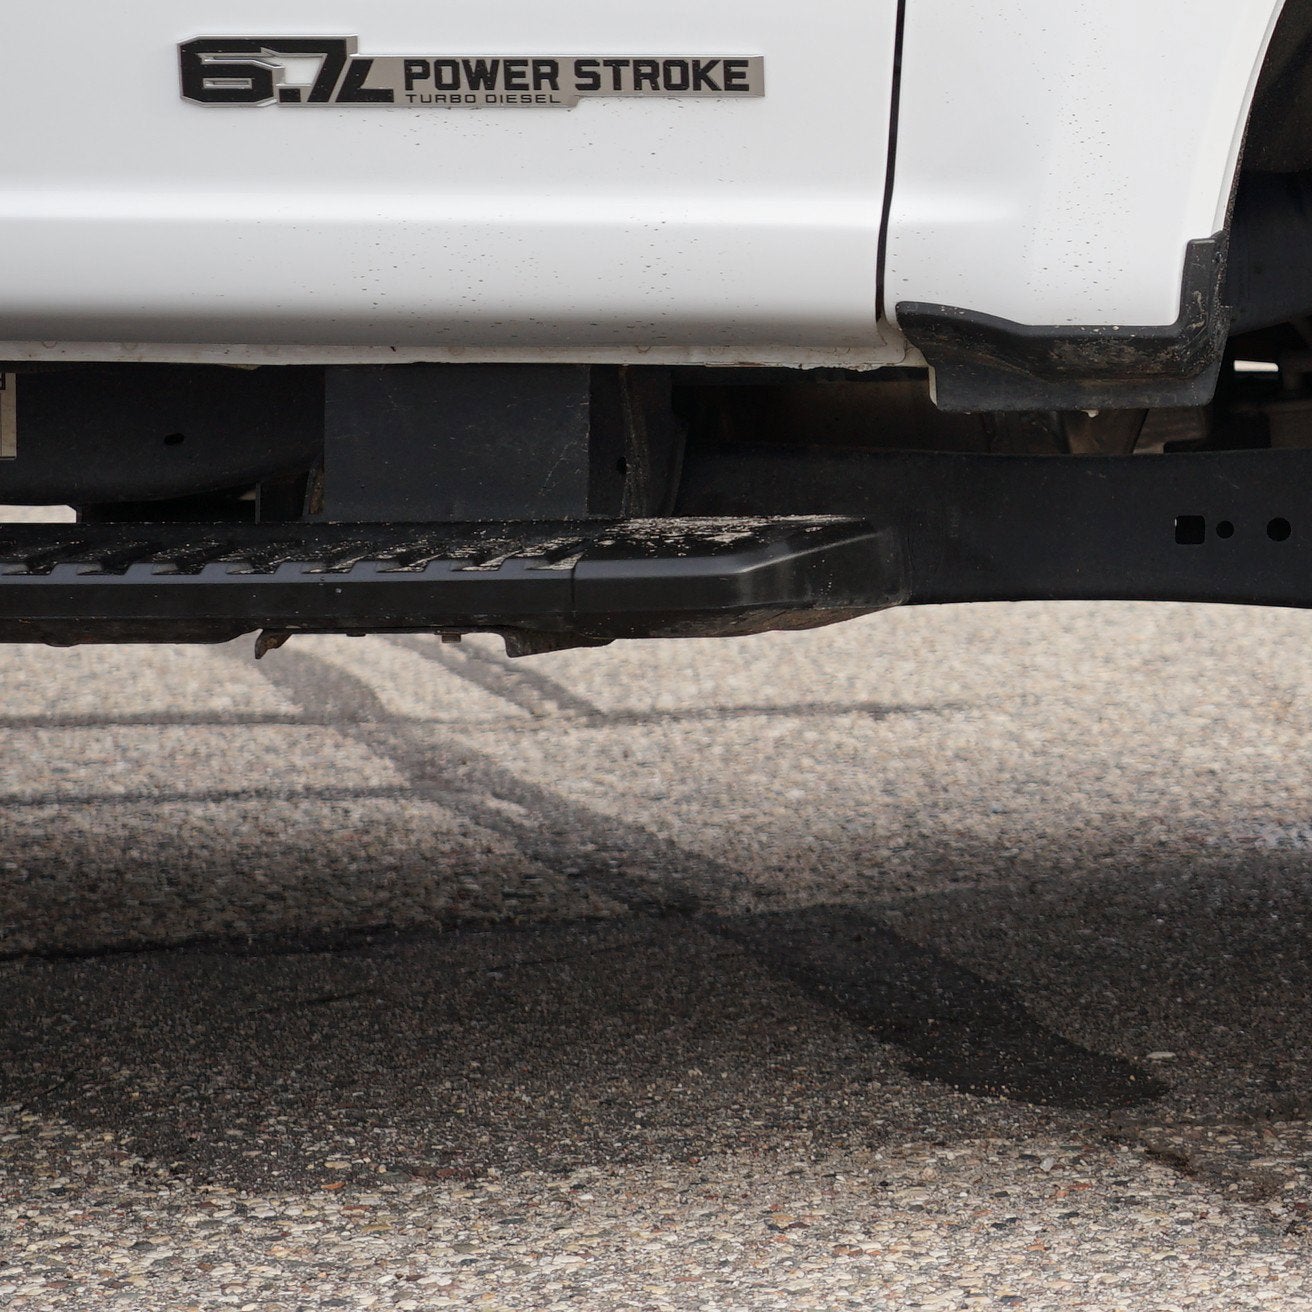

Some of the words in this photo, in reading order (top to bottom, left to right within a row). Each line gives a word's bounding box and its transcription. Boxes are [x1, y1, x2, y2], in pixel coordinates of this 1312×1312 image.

[404, 59, 561, 92] POWER
[574, 59, 750, 92] STROKE
[406, 94, 476, 104] TURBO
[485, 94, 561, 104] DIESEL
